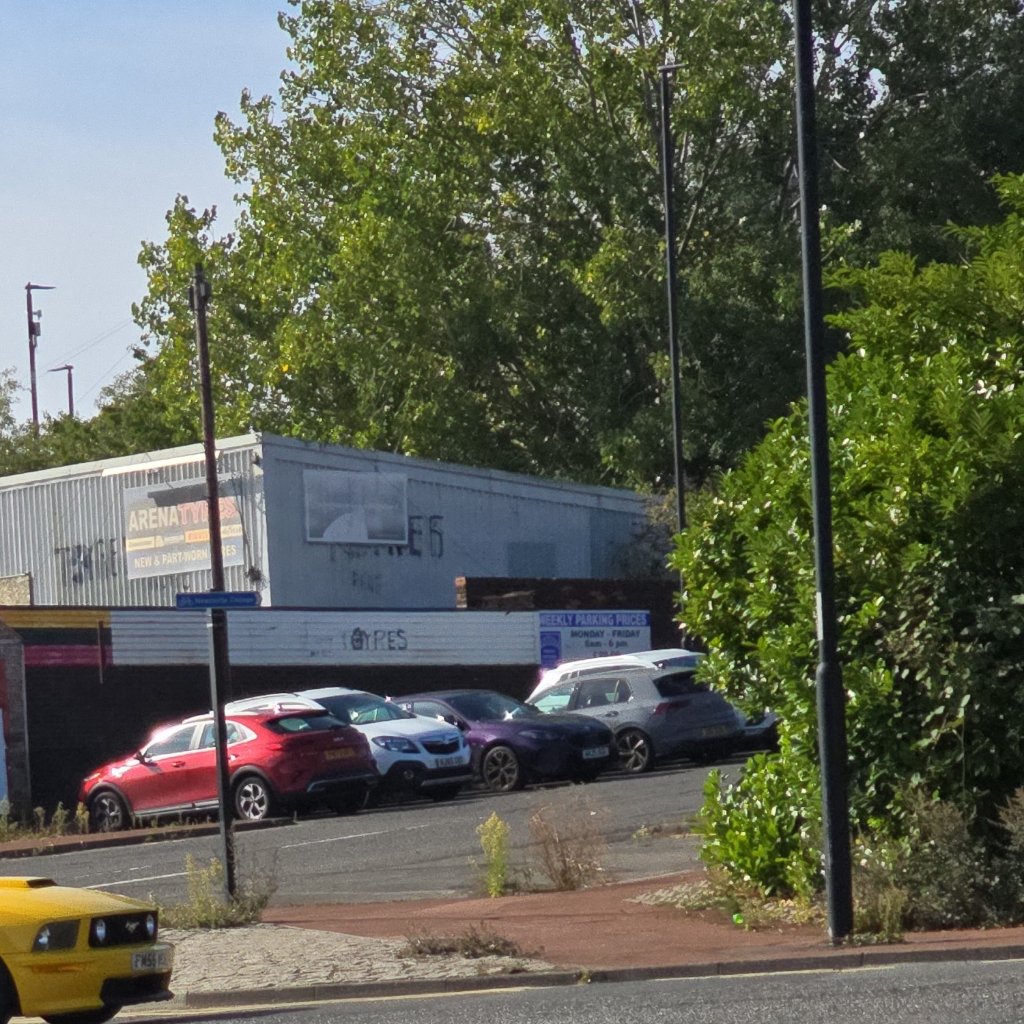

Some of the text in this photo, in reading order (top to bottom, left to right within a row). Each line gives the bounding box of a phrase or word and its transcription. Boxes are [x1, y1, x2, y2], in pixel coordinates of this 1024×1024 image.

[134, 556, 152, 569] NEW
[154, 556, 161, 566] &
[162, 549, 208, 564] PART-WORN
[575, 613, 615, 626] PARKING
[616, 613, 647, 626] PRICES
[570, 629, 605, 638] MONDAY
[612, 629, 641, 638] FRIDAY
